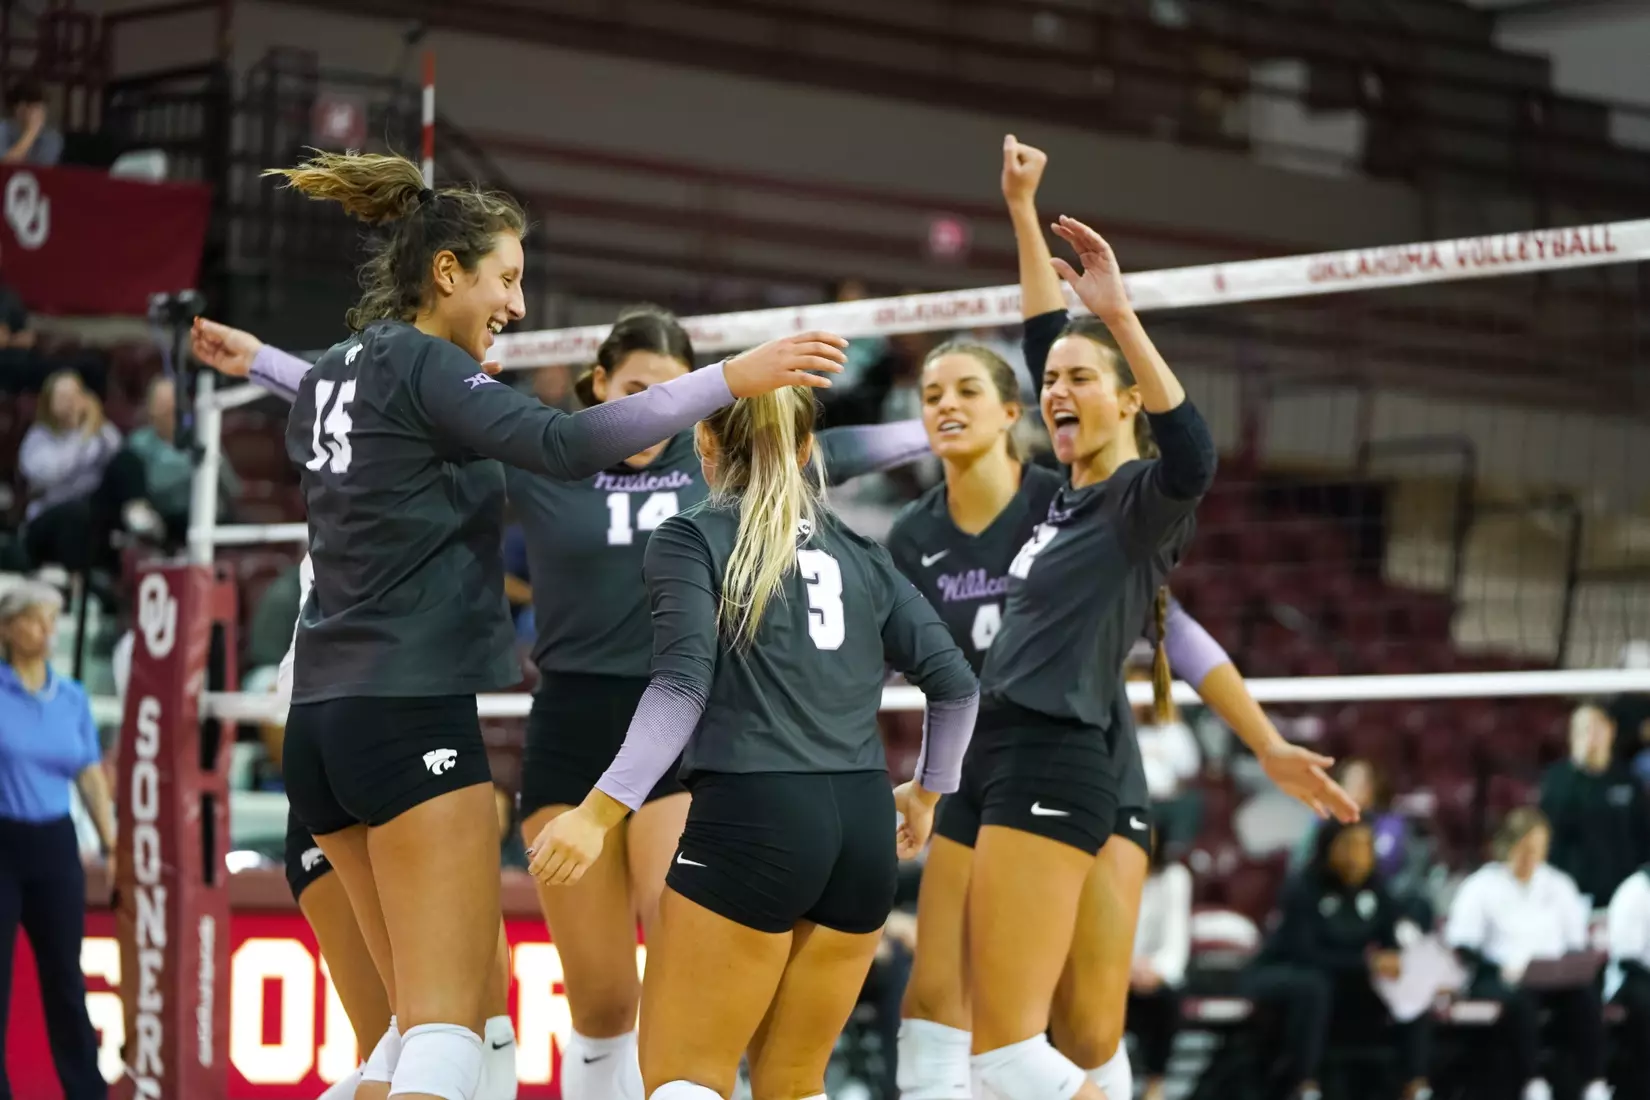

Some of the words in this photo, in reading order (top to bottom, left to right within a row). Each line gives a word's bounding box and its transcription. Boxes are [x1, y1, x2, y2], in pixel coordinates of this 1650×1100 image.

[1455, 223, 1618, 268] VOLLEYBALL
[305, 378, 357, 474] 15
[606, 491, 679, 545] 14
[797, 548, 846, 651] 3
[936, 567, 1010, 602] Wildca
